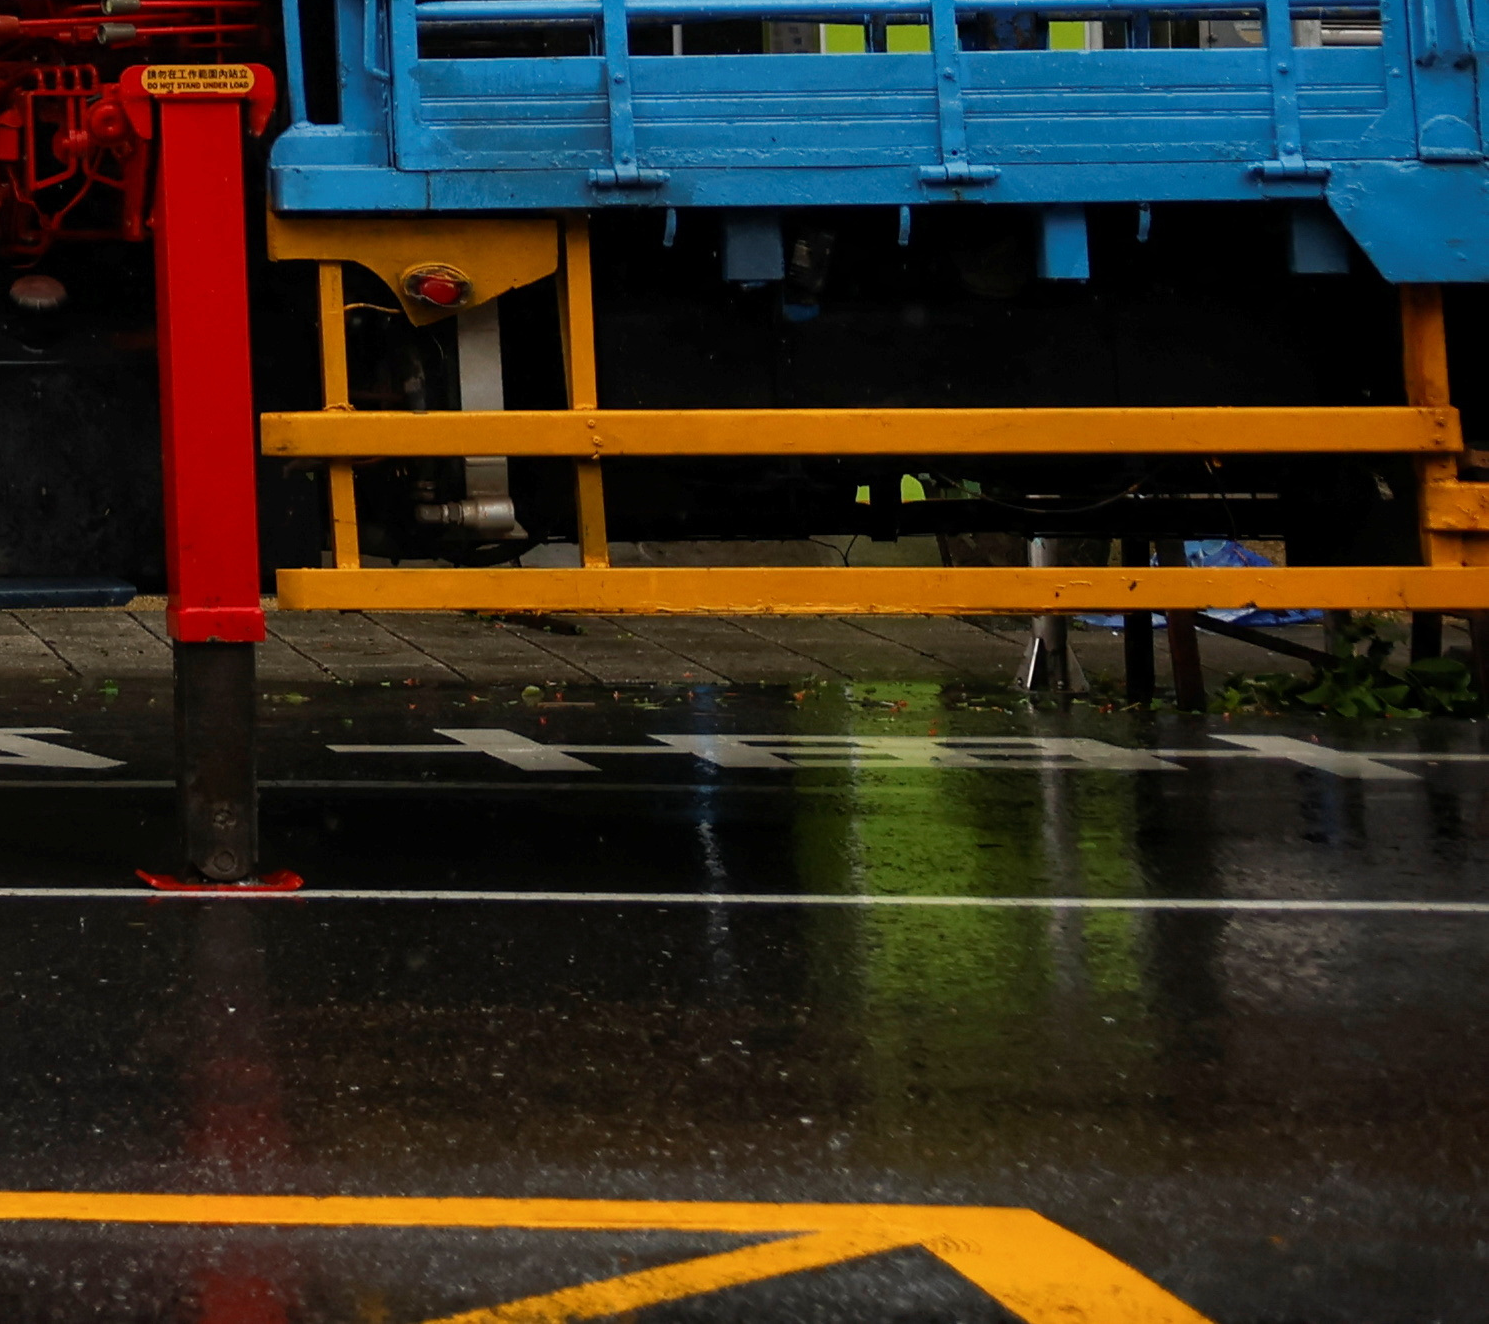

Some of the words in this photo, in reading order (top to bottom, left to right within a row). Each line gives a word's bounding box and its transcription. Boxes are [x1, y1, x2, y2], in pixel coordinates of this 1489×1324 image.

[147, 82, 158, 90] DO
[160, 81, 175, 90] NOT
[177, 81, 201, 89] STAND
[203, 81, 228, 89] UNDER
[230, 81, 249, 89] LOAD
